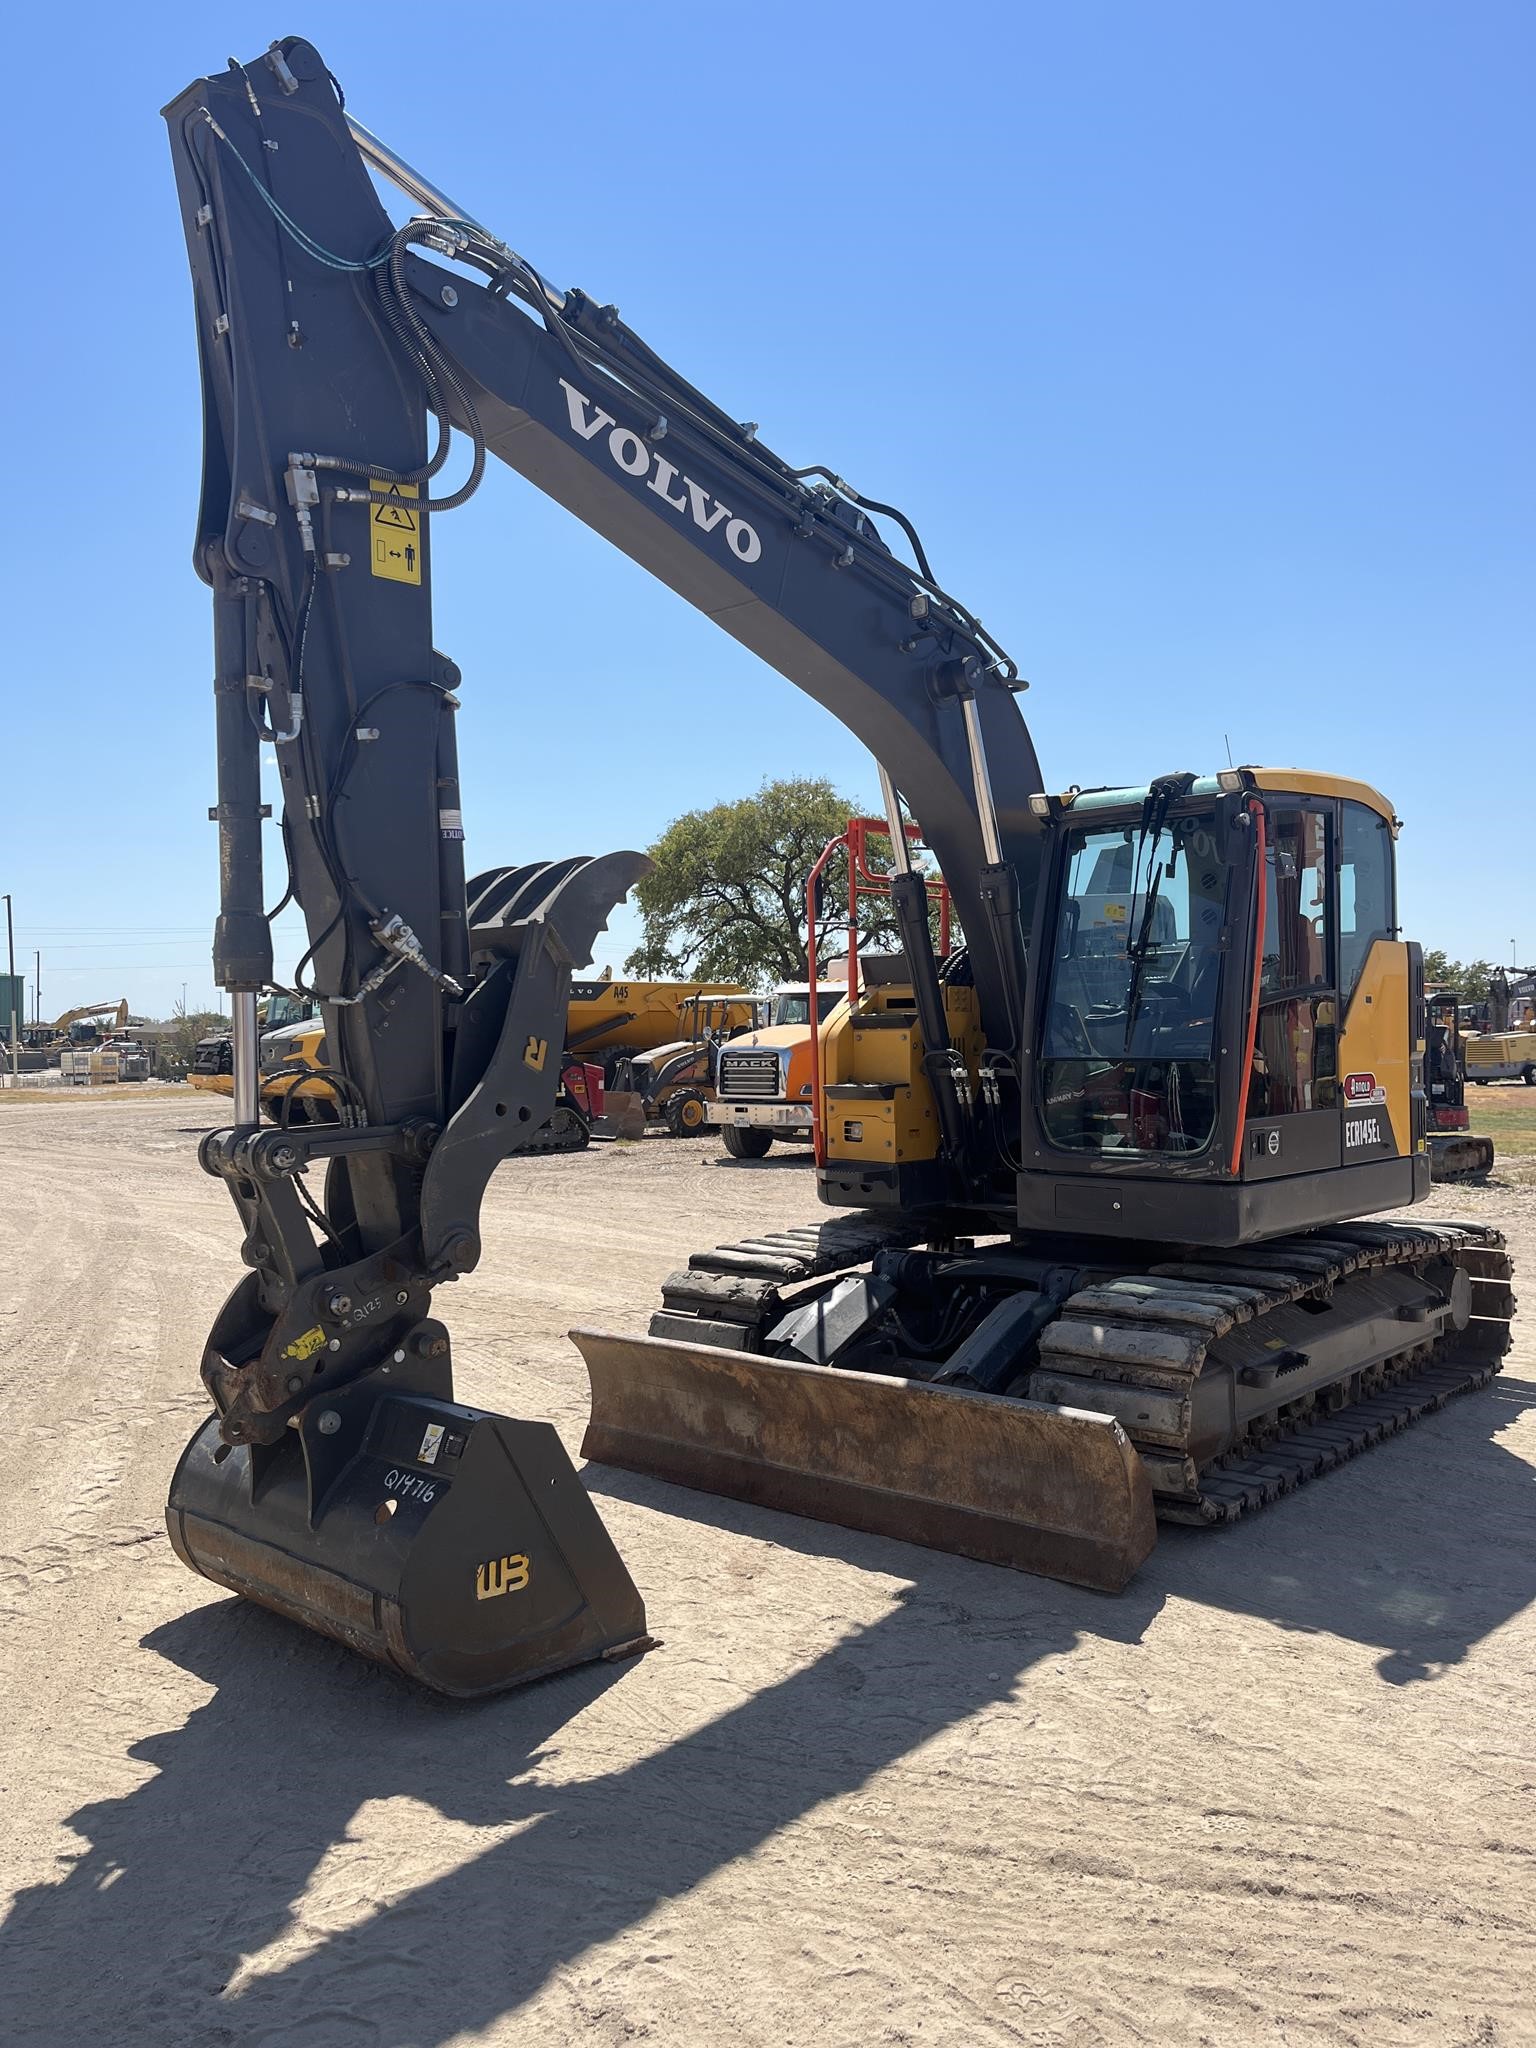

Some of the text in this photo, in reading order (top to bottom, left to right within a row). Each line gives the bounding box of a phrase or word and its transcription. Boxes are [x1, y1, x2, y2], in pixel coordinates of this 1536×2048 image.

[558, 377, 762, 563] VOLVO
[442, 830, 463, 839] OTICE
[614, 986, 628, 998] A45
[353, 1297, 382, 1321] Q125
[384, 1469, 435, 1502] Q14716
